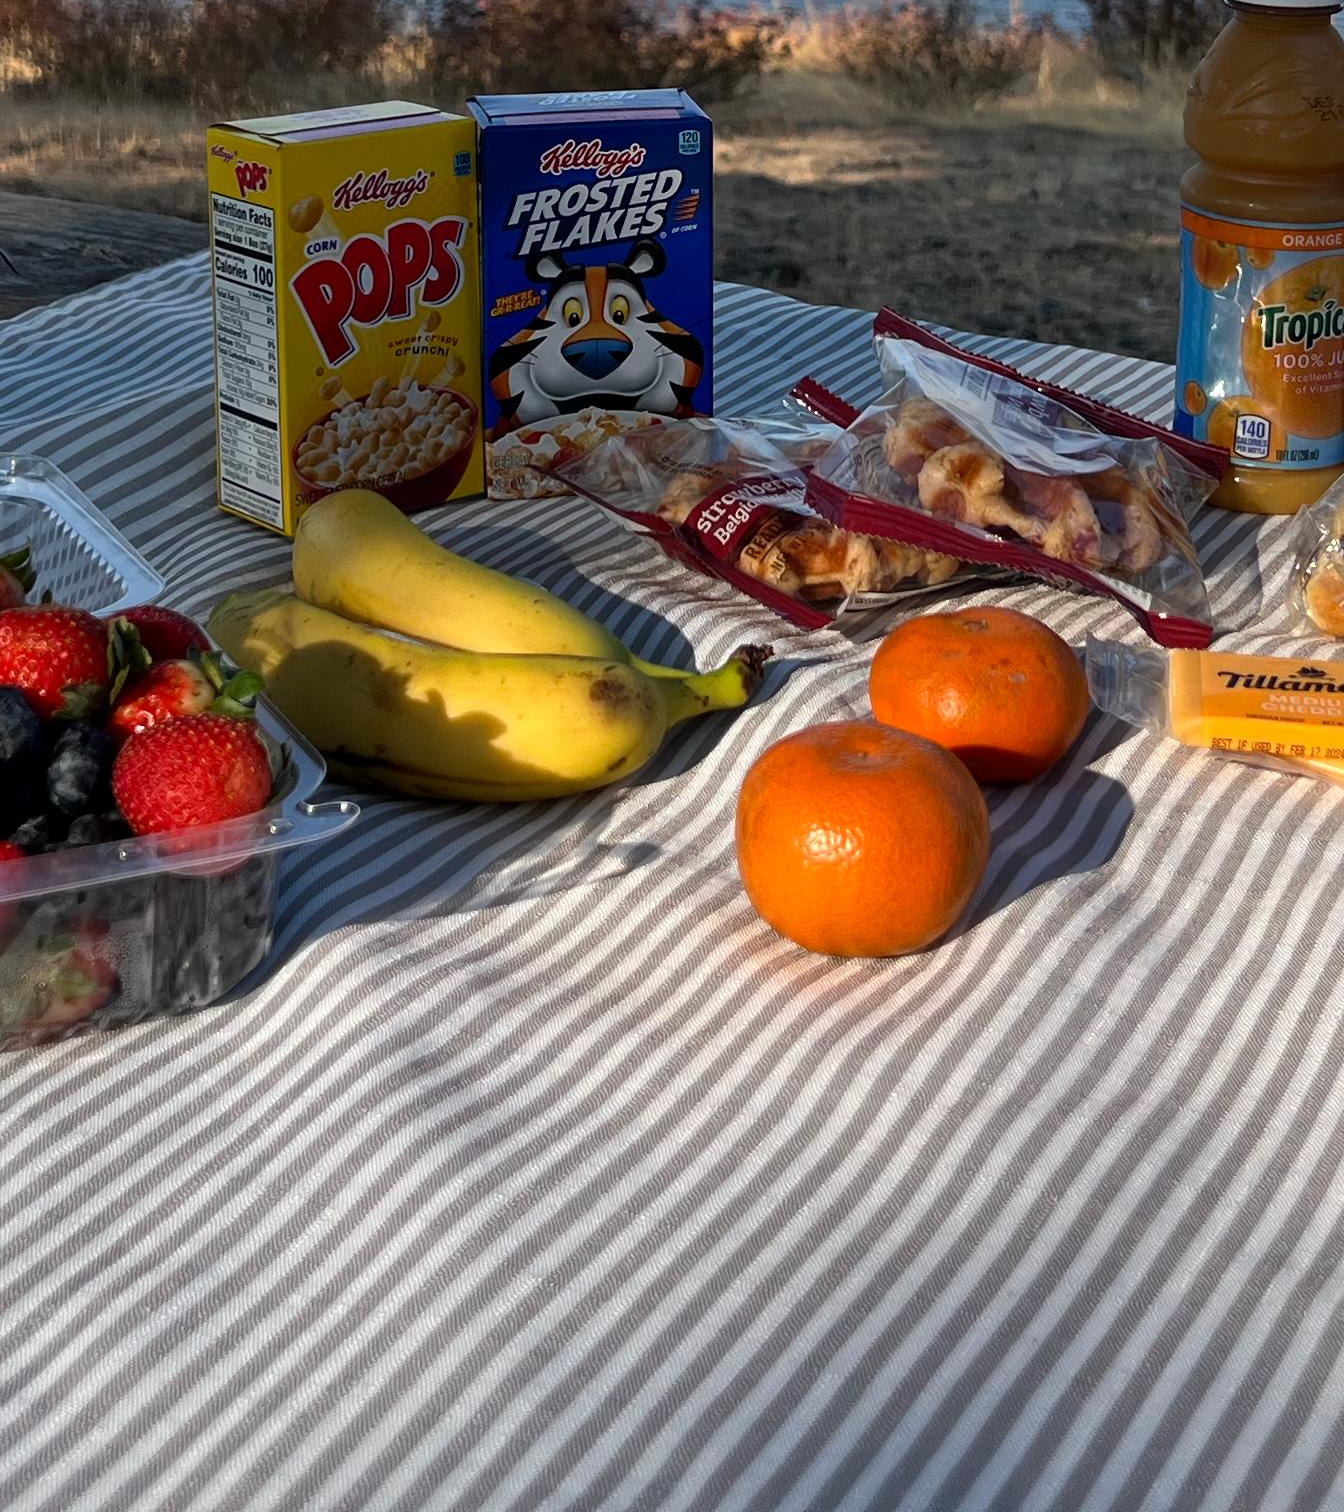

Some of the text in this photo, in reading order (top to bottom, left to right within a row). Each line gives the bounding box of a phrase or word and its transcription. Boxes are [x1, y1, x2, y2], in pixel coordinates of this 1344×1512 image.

[681, 131, 699, 143] 120
[540, 139, 646, 177] Kellogg's
[235, 162, 268, 199] POPS
[333, 169, 429, 209] Kellogg's
[508, 169, 683, 226] FROSTED
[213, 198, 272, 228] Nutrition Facts
[519, 202, 669, 256] FLAKES
[1282, 233, 1343, 248] ORANGE
[306, 240, 338, 255] CORN
[216, 256, 248, 280] Calories
[253, 263, 274, 288] 100
[291, 219, 464, 366] POPS
[388, 334, 460, 348] sweet crispy
[395, 345, 450, 357] crunch!
[1273, 353, 1325, 368] 100%
[1240, 419, 1266, 438] 140
[697, 475, 806, 535] strawberry
[1211, 736, 1232, 749] BEST
[1251, 740, 1272, 753] USED
[1289, 744, 1305, 756] FEB
[1310, 745, 1321, 757] 17
